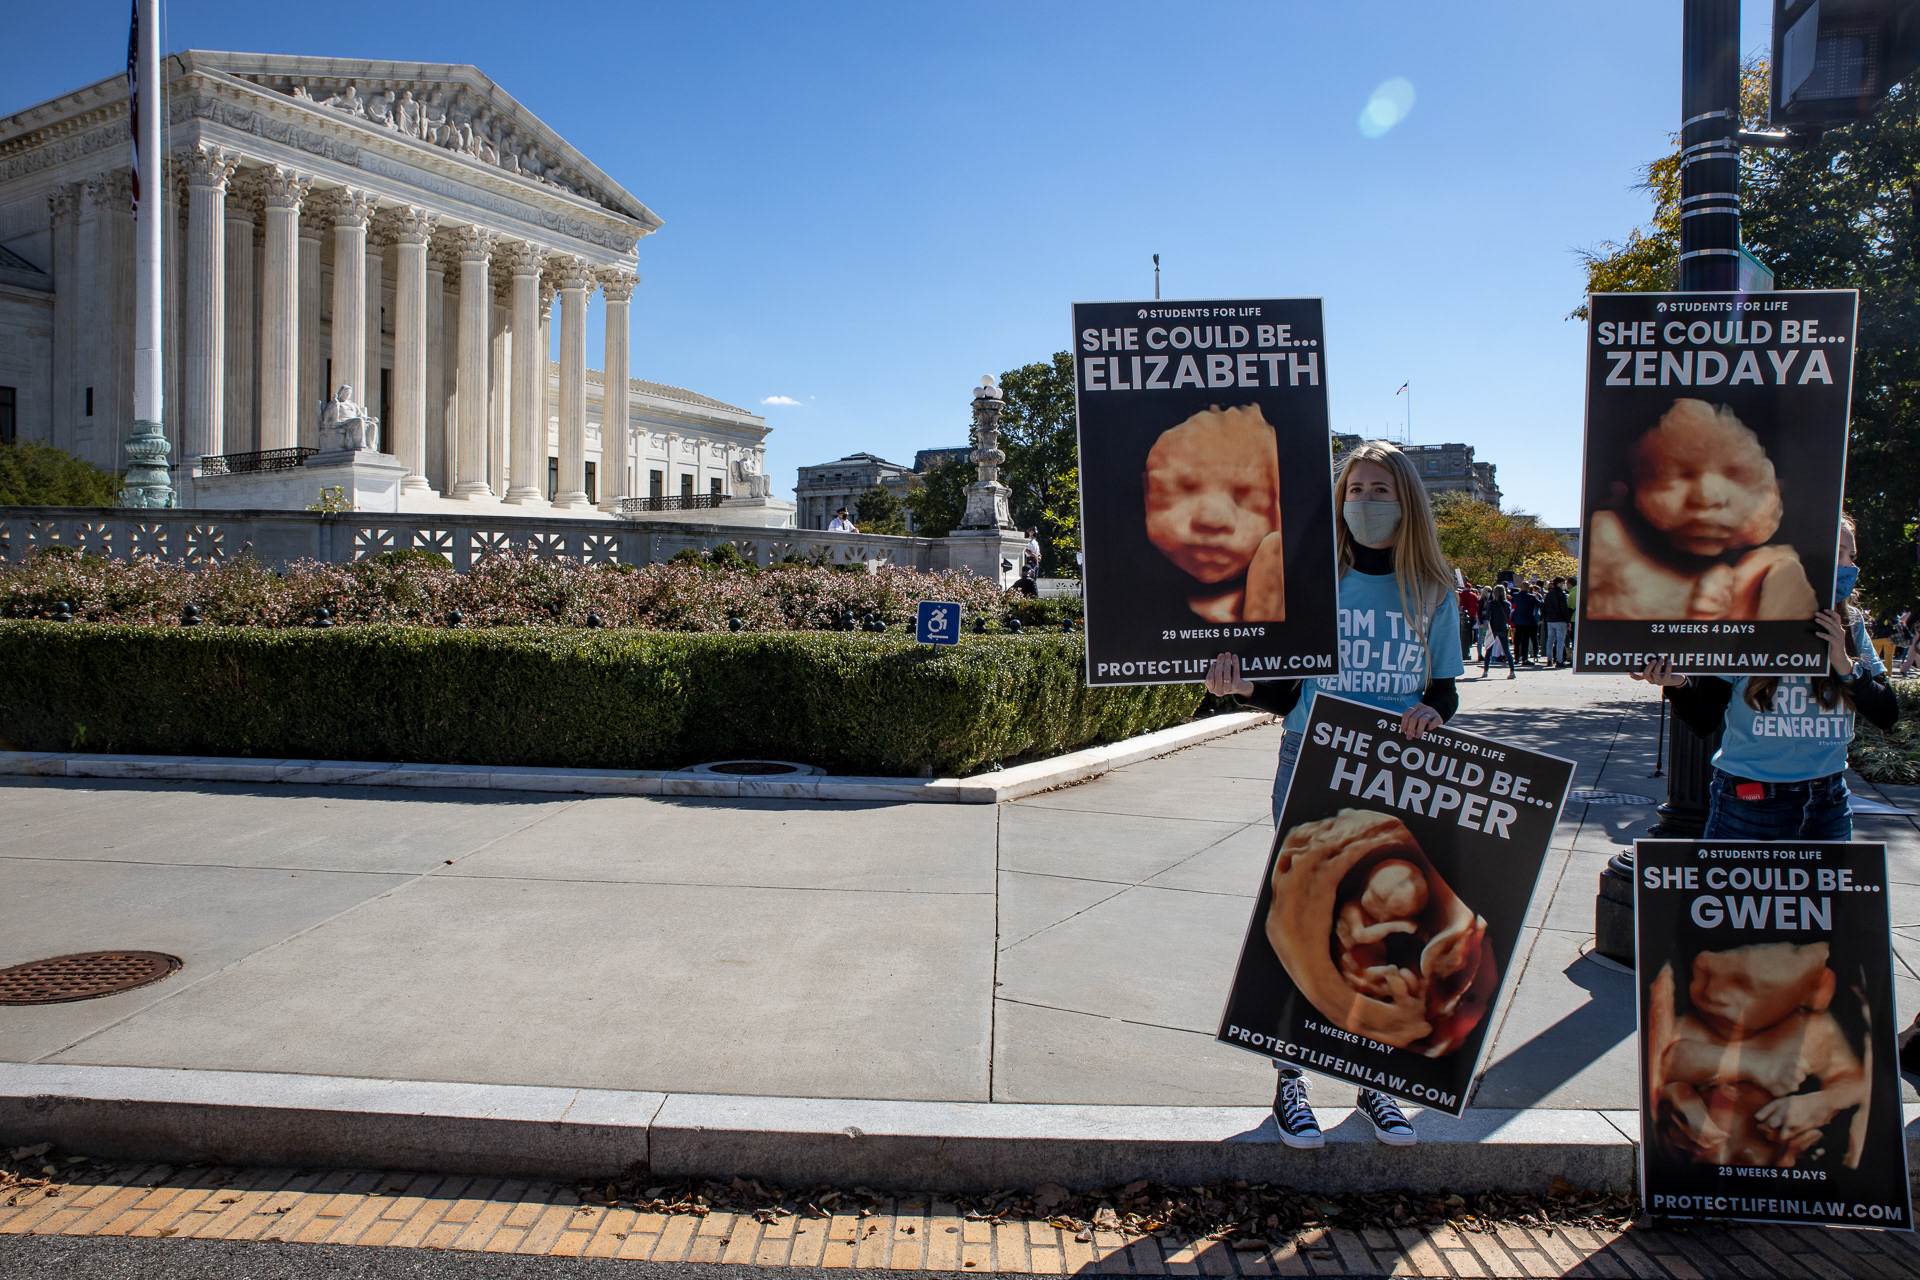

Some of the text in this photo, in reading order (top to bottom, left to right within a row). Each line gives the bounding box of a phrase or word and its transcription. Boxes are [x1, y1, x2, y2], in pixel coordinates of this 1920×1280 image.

[371, 160, 531, 219] EQUAL JUSTICE UNDER LAW
[1150, 307, 1261, 318] STUDENTS FOR LIFE
[1670, 302, 1788, 312] STUDENTS FOR LIFE
[1082, 325, 1317, 351] SHE COULD BE...
[1598, 320, 1845, 345] SHE COULD BE...
[1084, 352, 1318, 391] ELIZABETH
[1605, 350, 1833, 386] ZENDAYA
[1162, 627, 1265, 640] 29 WEEKS 6 DAYS
[1339, 609, 1428, 642] AM TH
[1651, 624, 1755, 633] 32 WEEKS 4 DAYS
[1098, 654, 1332, 676] PROTECTLIFLAW.COM
[1340, 639, 1424, 672] RO-LIFE
[1585, 653, 1821, 667] PROTECTLIFEINLAW.COM
[1454, 740, 1478, 755] FOR
[1482, 747, 1506, 762] LIFE
[1312, 722, 1552, 809] SHE COULD BE...
[1329, 757, 1517, 840] HARPER
[1711, 850, 1821, 860] STUDENTS FOR LIFE
[1644, 866, 1880, 892] SHE COULD BE...
[1691, 895, 1832, 930] GWEN
[1304, 1019, 1394, 1054] 14 WEEKS 1 DAY
[1228, 1025, 1456, 1108] PROTECTLIFEINLAW.COM
[1718, 1167, 1827, 1180] 29 WEEKS 4 DAYS
[1654, 1194, 1902, 1220] PROTECTLIFEINLAW.COM
